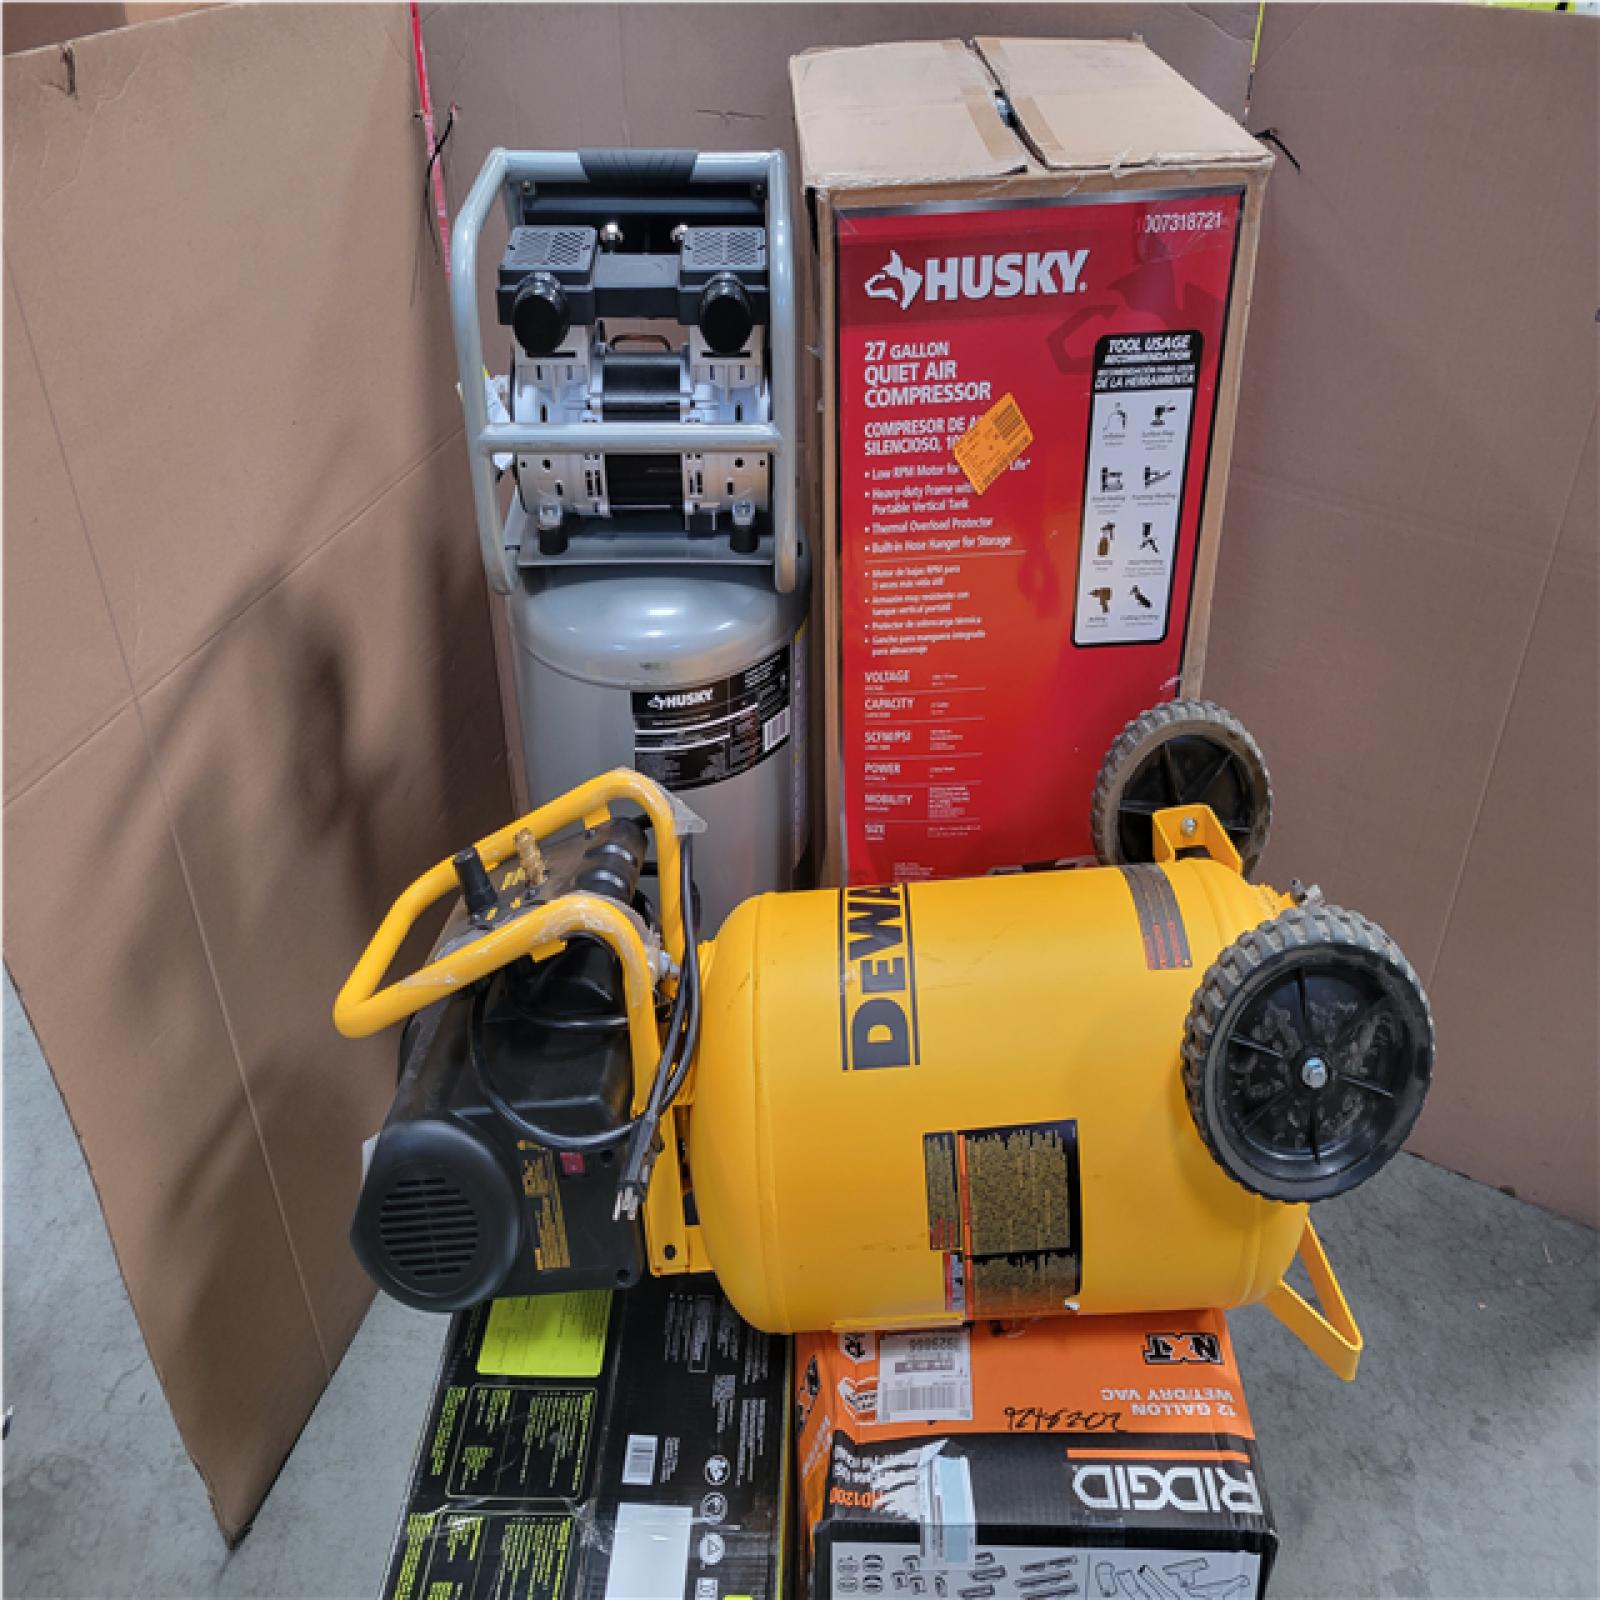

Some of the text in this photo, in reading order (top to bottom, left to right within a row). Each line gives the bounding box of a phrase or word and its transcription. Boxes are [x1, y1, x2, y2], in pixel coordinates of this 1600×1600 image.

[925, 250, 1089, 300] HUSKY
[864, 340, 949, 360] 27 GALLON
[864, 360, 957, 387] QUIET AIR
[864, 382, 992, 409] COMPRESSOR
[864, 417, 945, 438] COMPRESOR
[949, 417, 965, 432] DE
[872, 468, 891, 480] Low
[894, 466, 914, 477] RPM
[917, 464, 944, 476] Motor
[872, 486, 923, 500] Heavy-duty
[925, 484, 953, 496] Frame
[872, 498, 970, 516] Portable Vertical Tank
[872, 517, 993, 535] Thermal Overload Protector
[905, 541, 926, 551] Hose
[928, 538, 961, 551] Hanger
[962, 536, 976, 548] for
[977, 535, 1012, 548] Storage
[864, 670, 910, 683] VOLTAGE
[665, 688, 713, 707] HUSKY
[864, 697, 915, 711] CAPACITY
[864, 763, 901, 774] POWER
[1146, 1333, 1223, 1364] NXT
[1099, 1387, 1234, 1402] WET/DRY VAC
[1130, 1403, 1238, 1417] 12 GALLON
[1072, 1465, 1264, 1516] RIDGID
